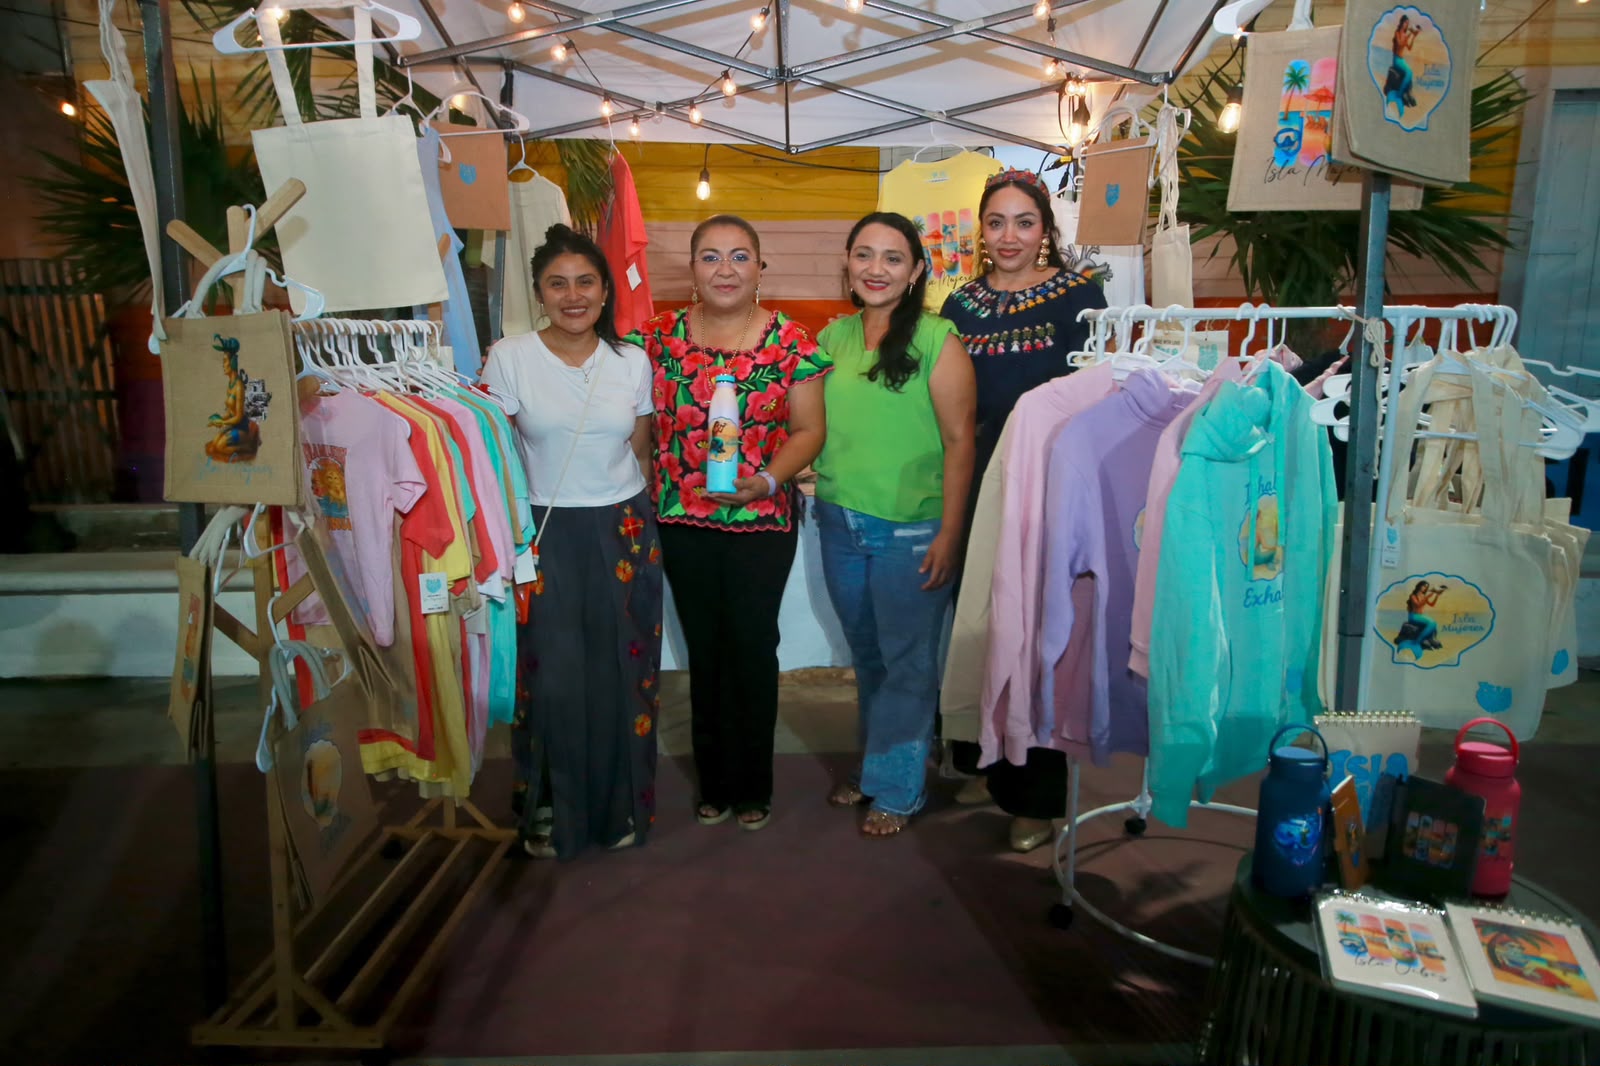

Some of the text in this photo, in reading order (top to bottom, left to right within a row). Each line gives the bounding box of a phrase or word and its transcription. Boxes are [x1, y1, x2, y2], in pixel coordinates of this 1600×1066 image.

[1263, 156, 1301, 184] Isla
[1453, 613, 1475, 624] Isla
[1441, 623, 1485, 634] Mujeres
